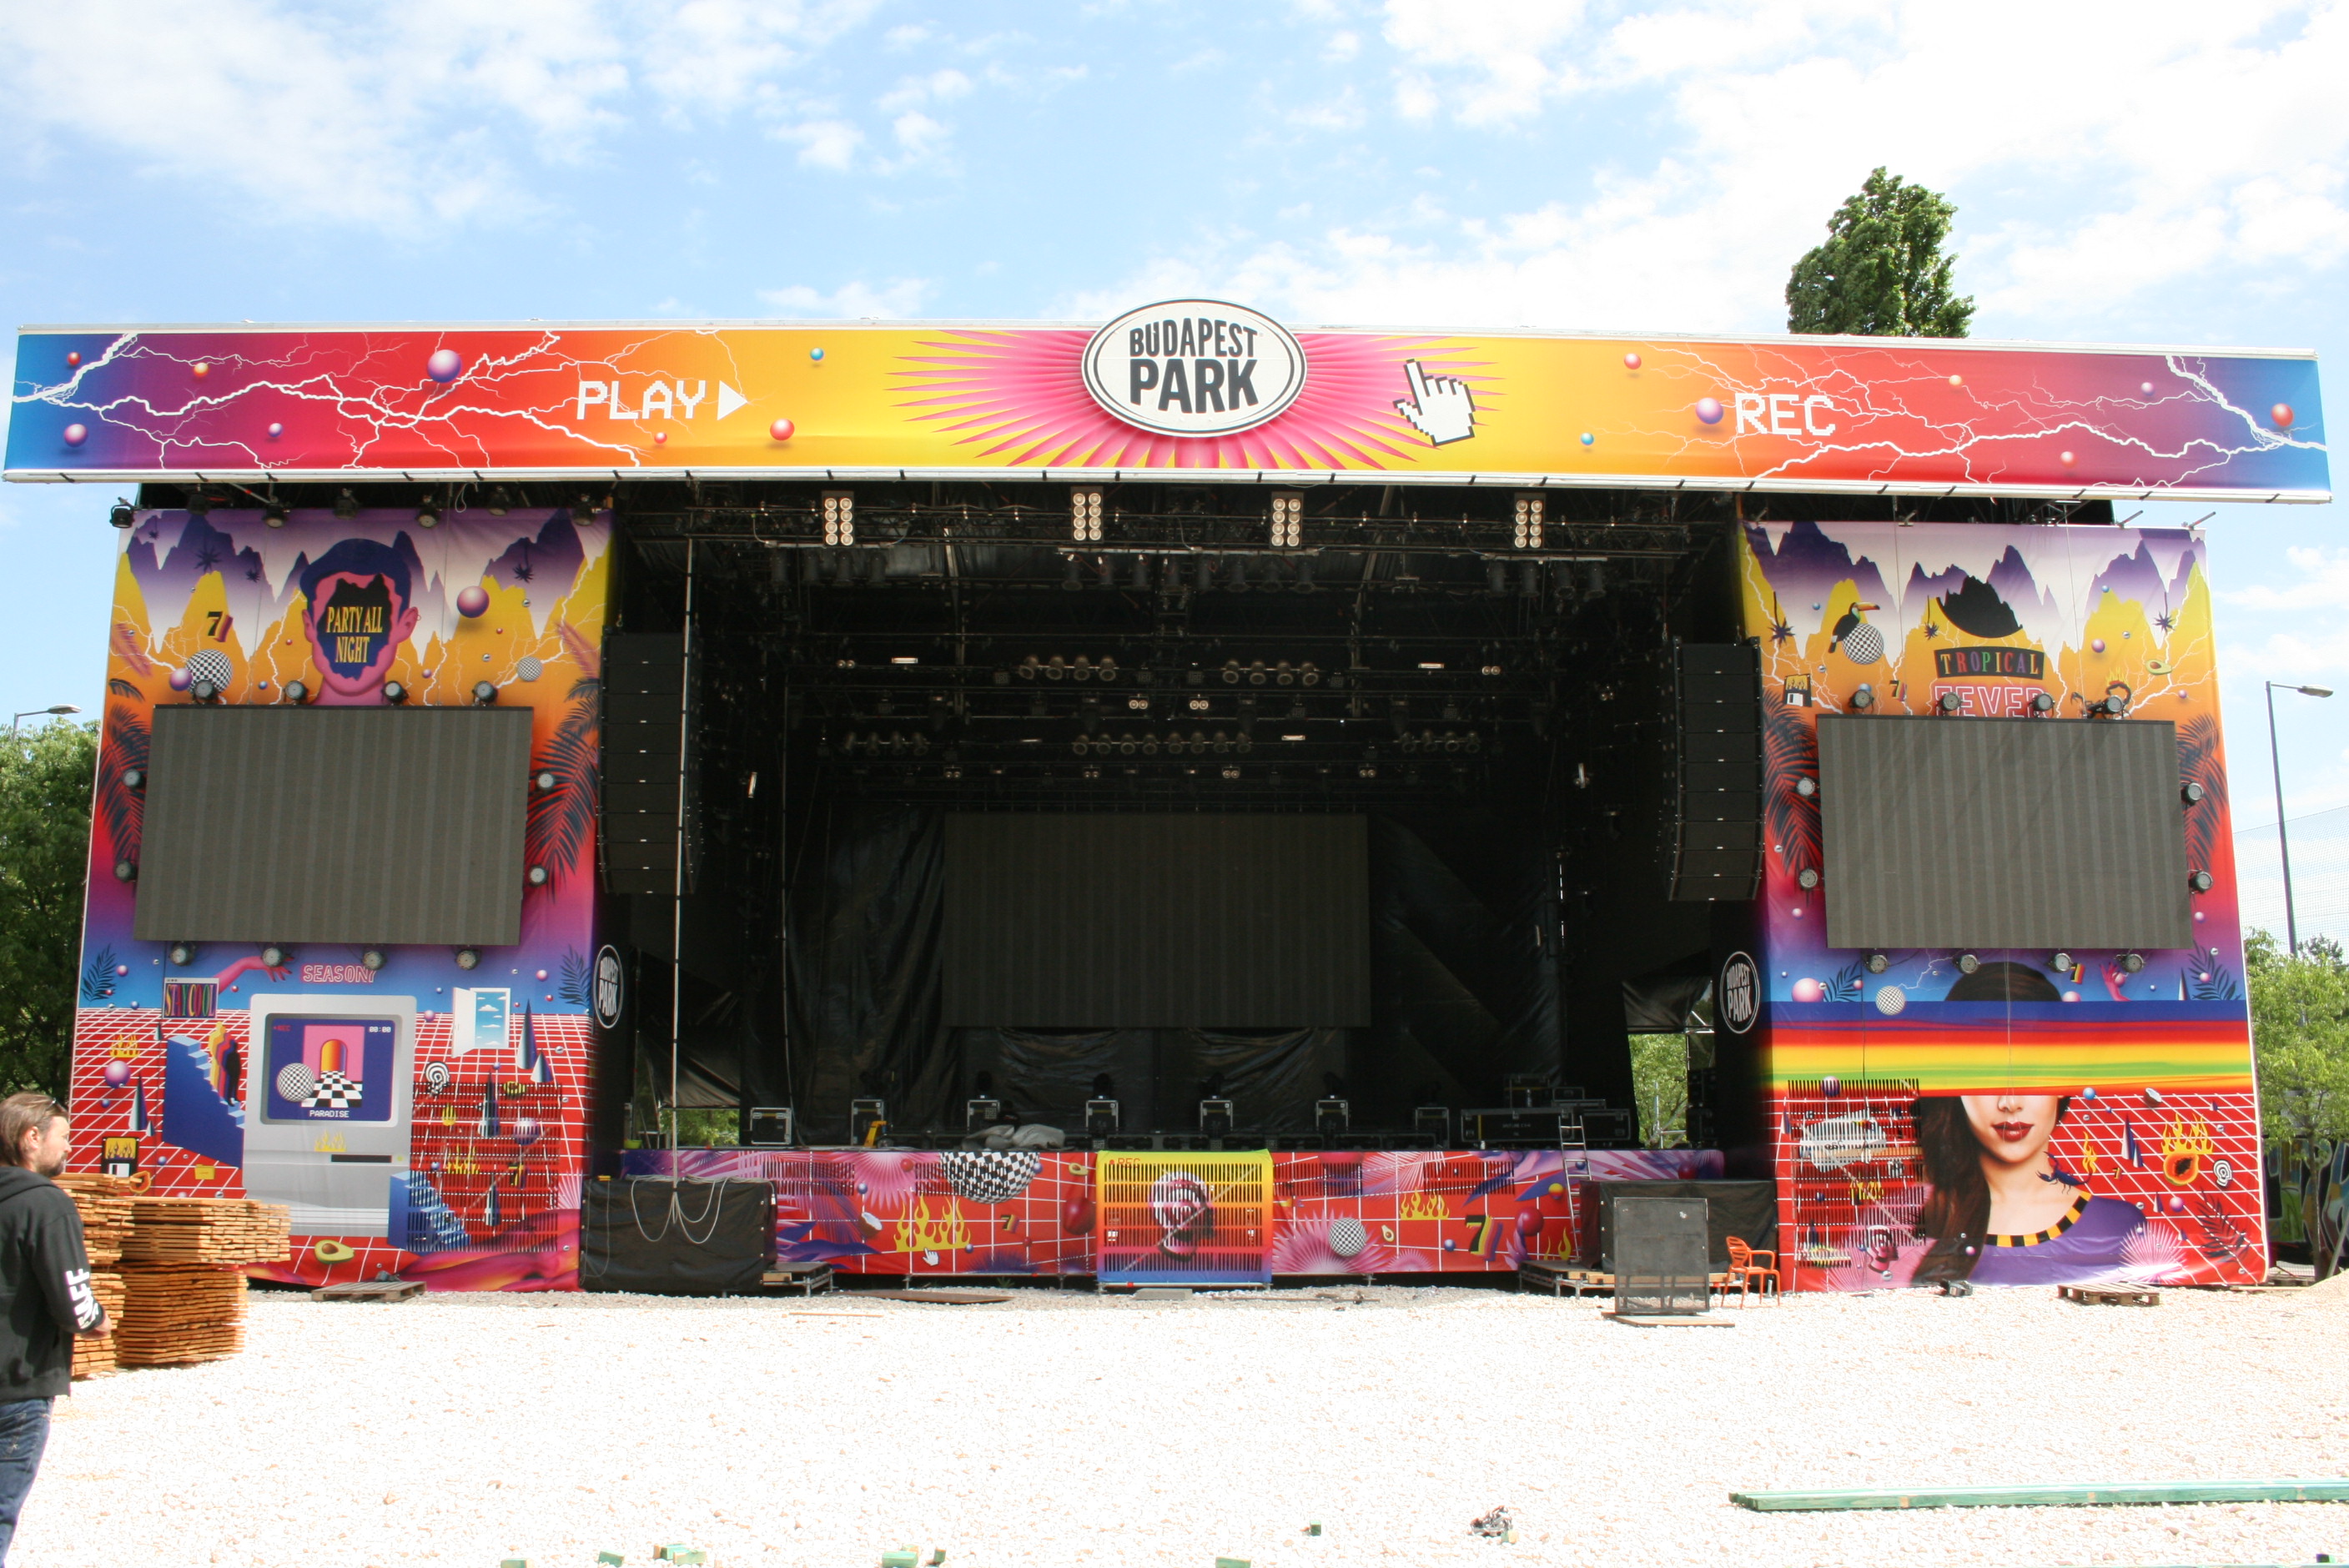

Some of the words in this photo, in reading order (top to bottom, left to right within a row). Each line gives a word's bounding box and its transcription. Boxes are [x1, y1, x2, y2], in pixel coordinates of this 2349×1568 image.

[1129, 318, 1258, 357] BUDAPEST
[577, 380, 706, 420] PLAY
[1129, 359, 1259, 414] PARK
[1735, 393, 1836, 436] REC
[326, 606, 363, 633] PARTY
[363, 606, 383, 633] ALL
[335, 636, 370, 663] NIGHT
[1940, 651, 2040, 676] TROPICAL
[1727, 985, 1752, 1023] PARK
[1466, 1214, 1495, 1256] 7
